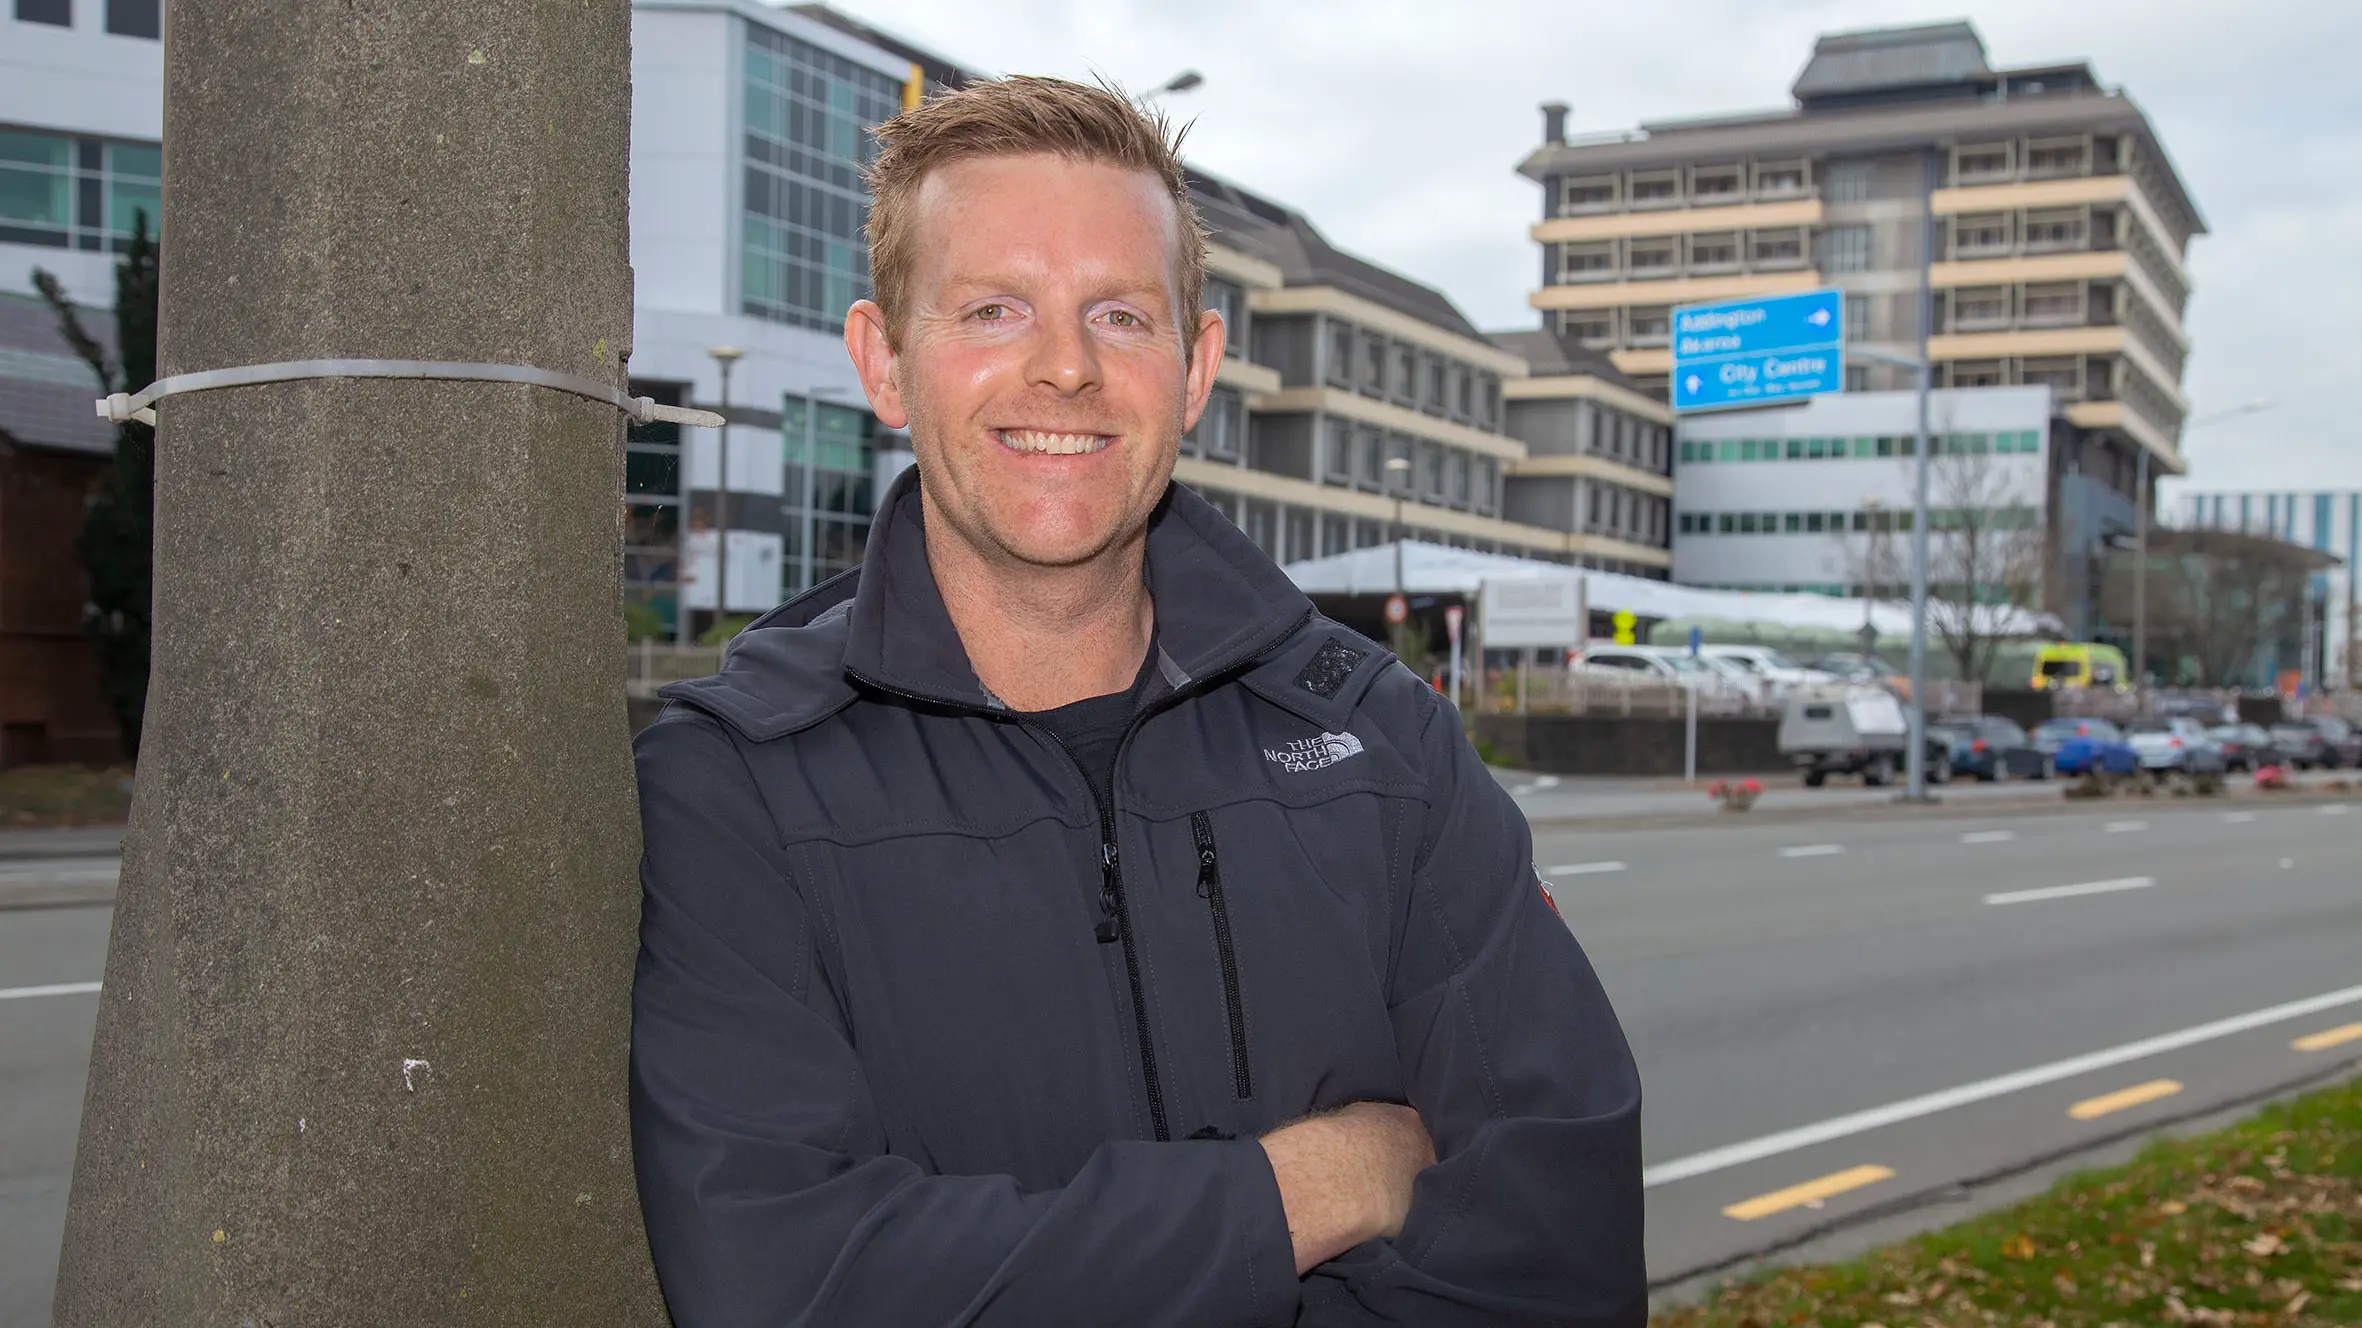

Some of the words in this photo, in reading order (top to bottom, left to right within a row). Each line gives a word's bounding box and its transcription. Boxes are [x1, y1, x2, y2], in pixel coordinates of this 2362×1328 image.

[1719, 362, 1758, 384] City
[1763, 357, 1827, 379] Centre
[1286, 737, 1324, 751] THE
[1264, 745, 1327, 763] NORTH
[1285, 758, 1333, 772] FACE
